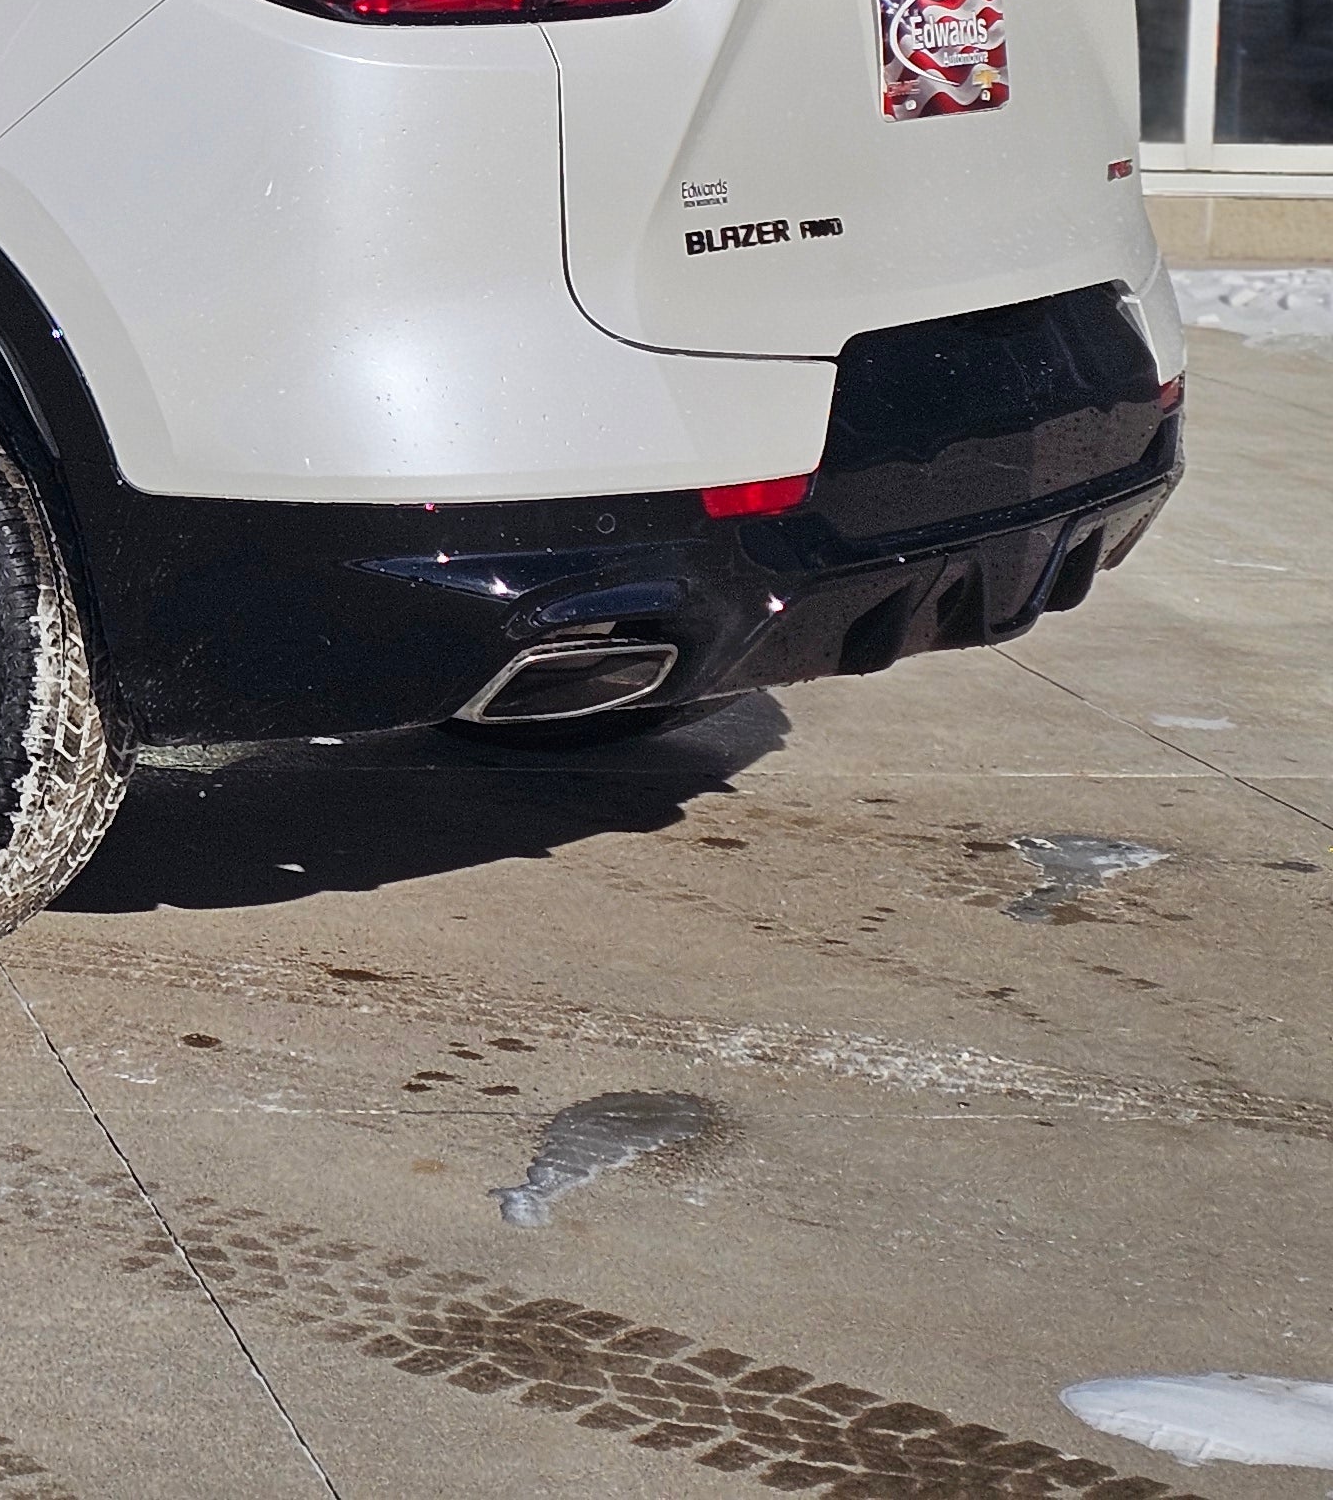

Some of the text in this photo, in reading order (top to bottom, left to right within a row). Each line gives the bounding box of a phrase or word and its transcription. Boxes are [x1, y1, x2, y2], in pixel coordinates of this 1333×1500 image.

[909, 12, 989, 50] Edwards
[681, 178, 728, 199] Edwards
[684, 219, 791, 255] BLAZER
